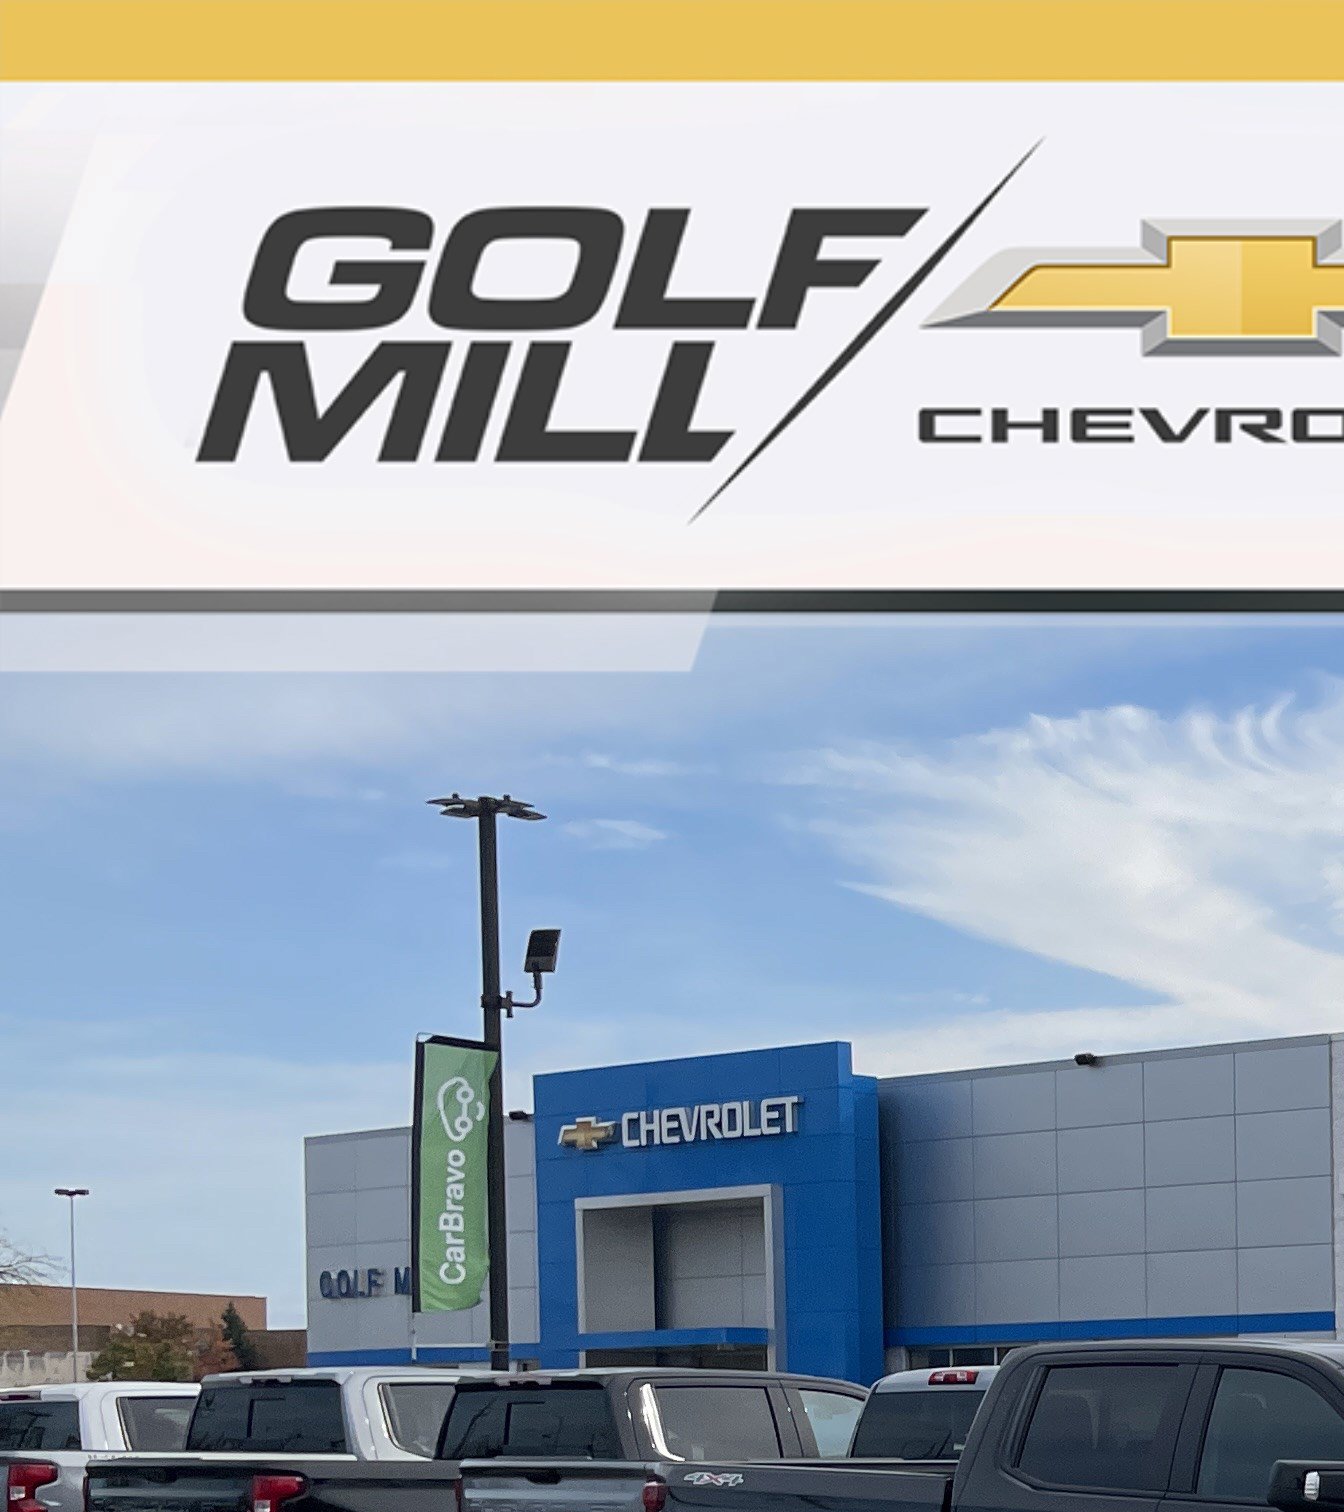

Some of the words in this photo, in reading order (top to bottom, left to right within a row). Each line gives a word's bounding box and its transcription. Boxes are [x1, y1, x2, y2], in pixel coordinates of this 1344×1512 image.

[621, 1096, 800, 1148] CHEVROLET
[439, 1149, 467, 1285] CarBravo
[319, 1267, 385, 1299] GOLF
